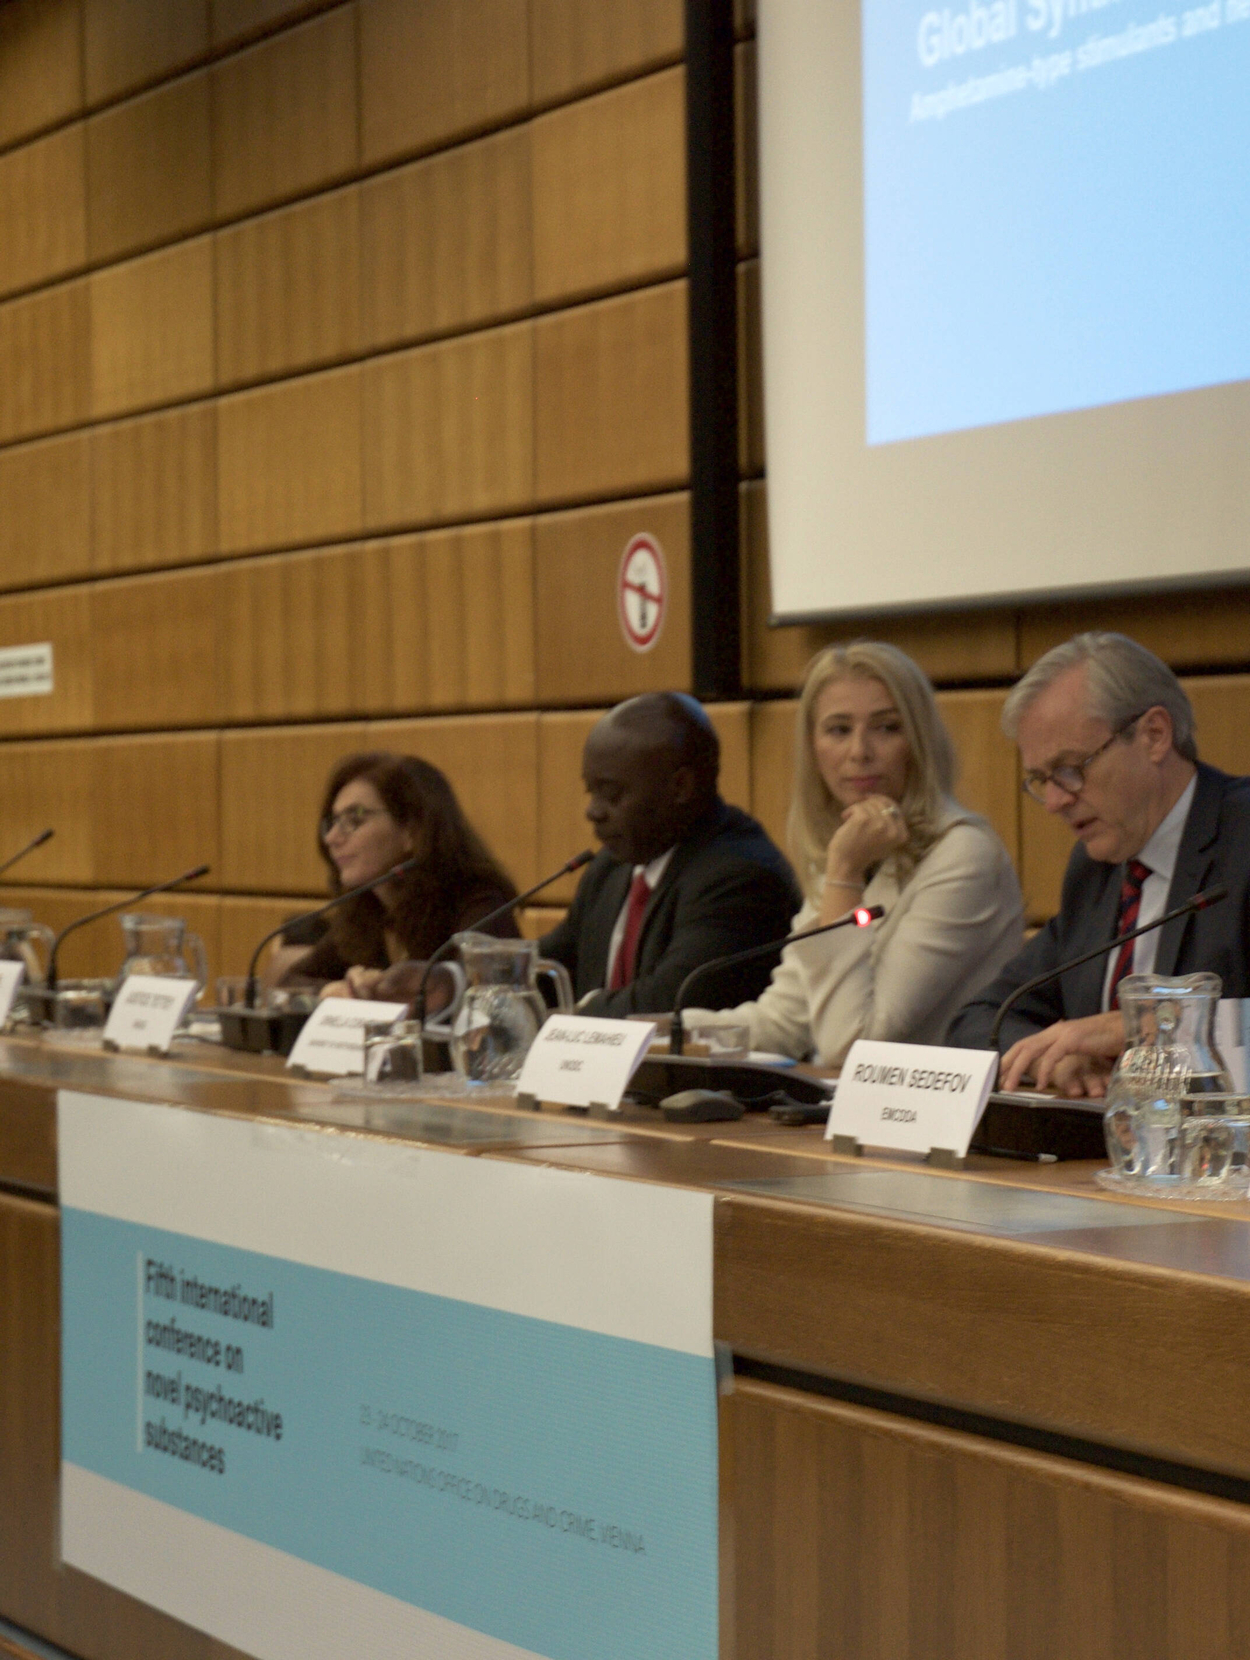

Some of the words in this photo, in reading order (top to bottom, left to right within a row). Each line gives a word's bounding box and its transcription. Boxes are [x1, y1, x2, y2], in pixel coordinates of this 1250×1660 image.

[916, 0, 1017, 68] Global
[1181, 0, 1221, 37] and
[853, 1063, 908, 1087] ROUMEN
[908, 1068, 973, 1094] SEDEFOV
[146, 1258, 177, 1301] Fifth
[179, 1268, 274, 1330] international
[146, 1316, 221, 1367] conference
[225, 1343, 244, 1374] on
[145, 1370, 182, 1405] novel
[183, 1384, 284, 1442] psychoactive
[145, 1416, 226, 1475] substances
[491, 1488, 530, 1520] DRUGS
[532, 1502, 557, 1528] AND
[599, 1524, 647, 1555] VIENNA
